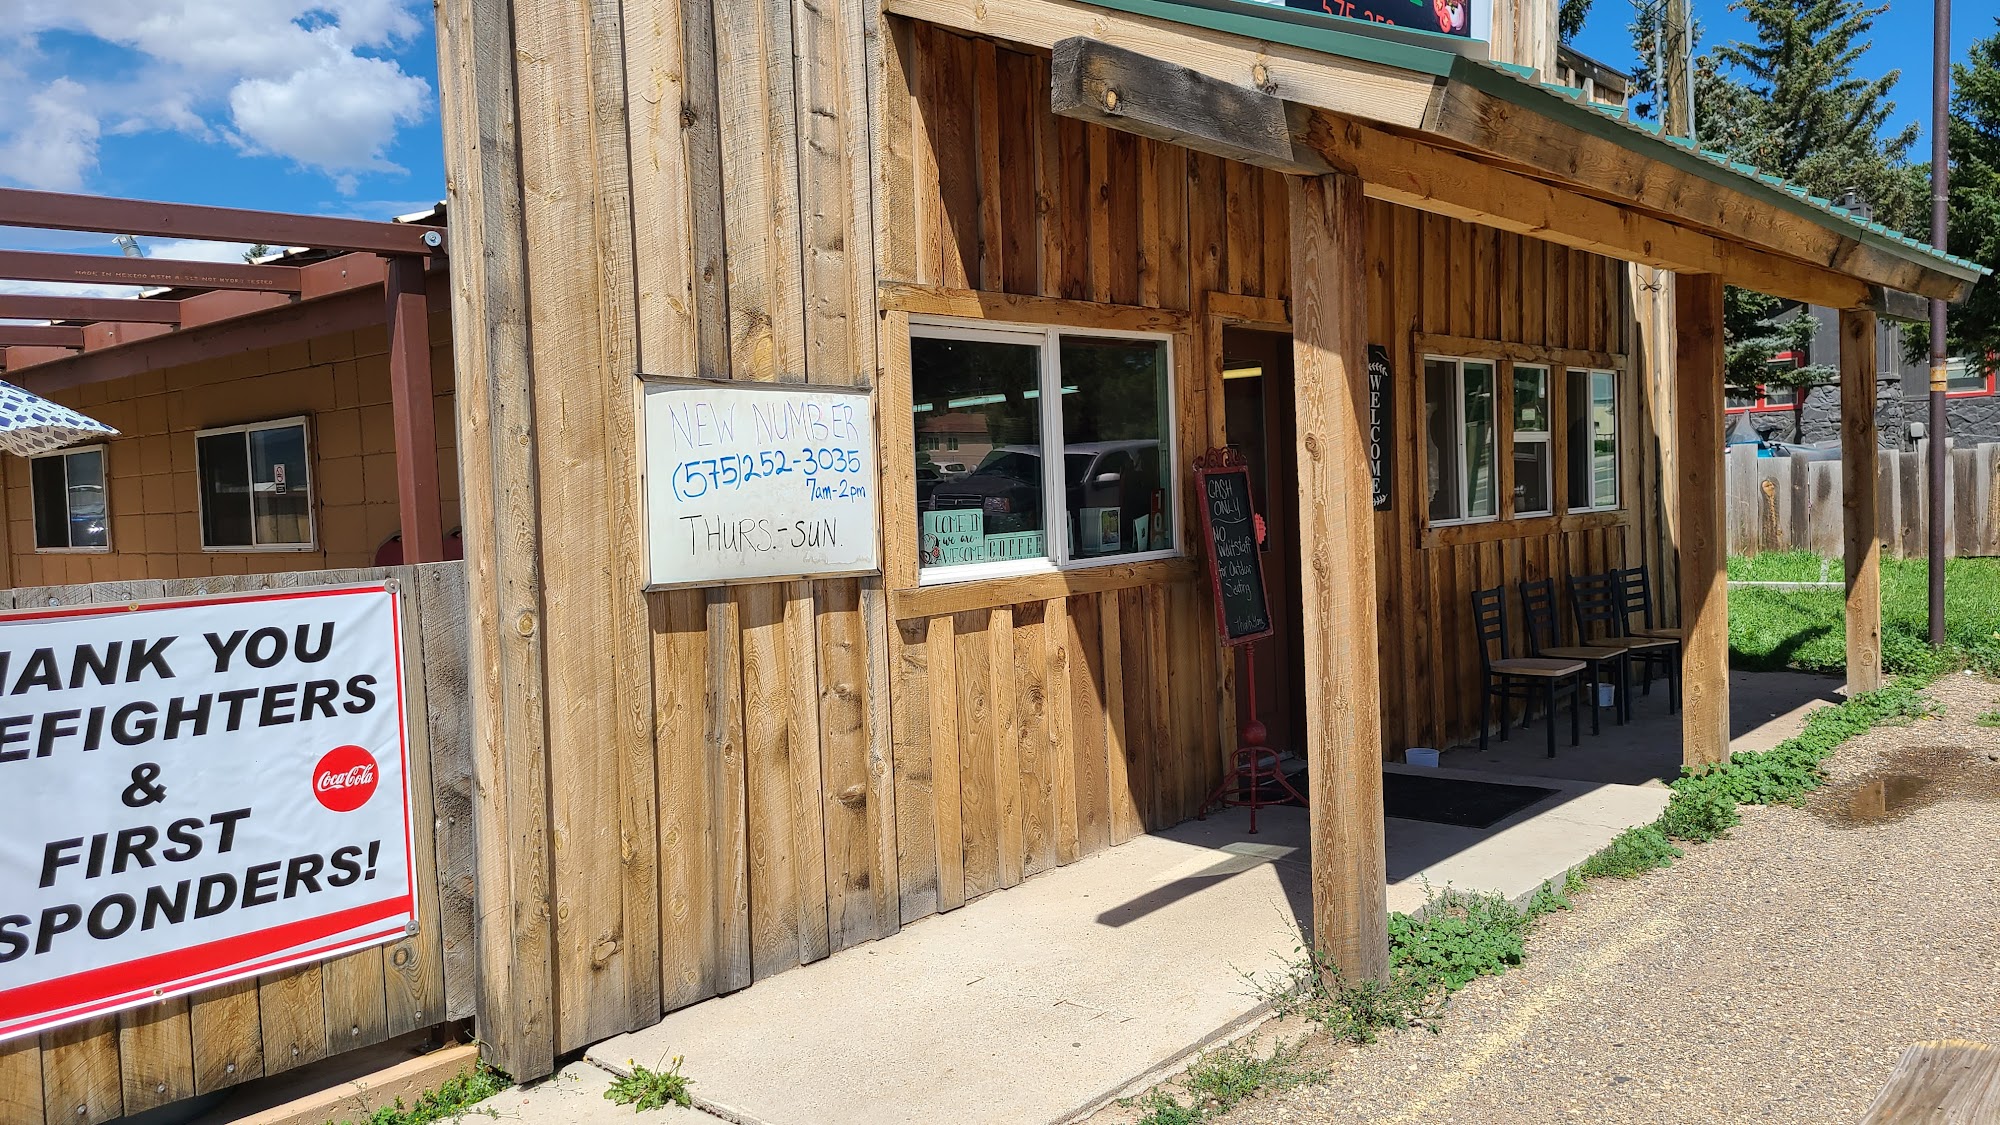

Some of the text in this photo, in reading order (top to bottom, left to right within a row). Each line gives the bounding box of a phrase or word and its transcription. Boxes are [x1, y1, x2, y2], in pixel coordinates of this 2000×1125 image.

[668, 400, 859, 452] NEW NUMBER
[1369, 374, 1382, 494] WELCOME
[672, 447, 861, 502] (575)252-3035
[806, 478, 866, 503] 7am-2pm
[1208, 479, 1232, 499] CASH
[1214, 497, 1240, 520] ONLY
[935, 513, 981, 534] COME IN
[1212, 526, 1226, 543] NO
[942, 536, 956, 546] we
[989, 536, 1041, 558] COFFEE
[937, 546, 984, 563] AWESOME
[1218, 560, 1227, 579] for
[1225, 579, 1252, 601] Seating
[202, 621, 336, 673] YOU
[0, 674, 377, 763] EFIGHTERS
[121, 762, 167, 808] &
[39, 807, 251, 888] FIRST
[0, 840, 380, 964] SPONDERS!
